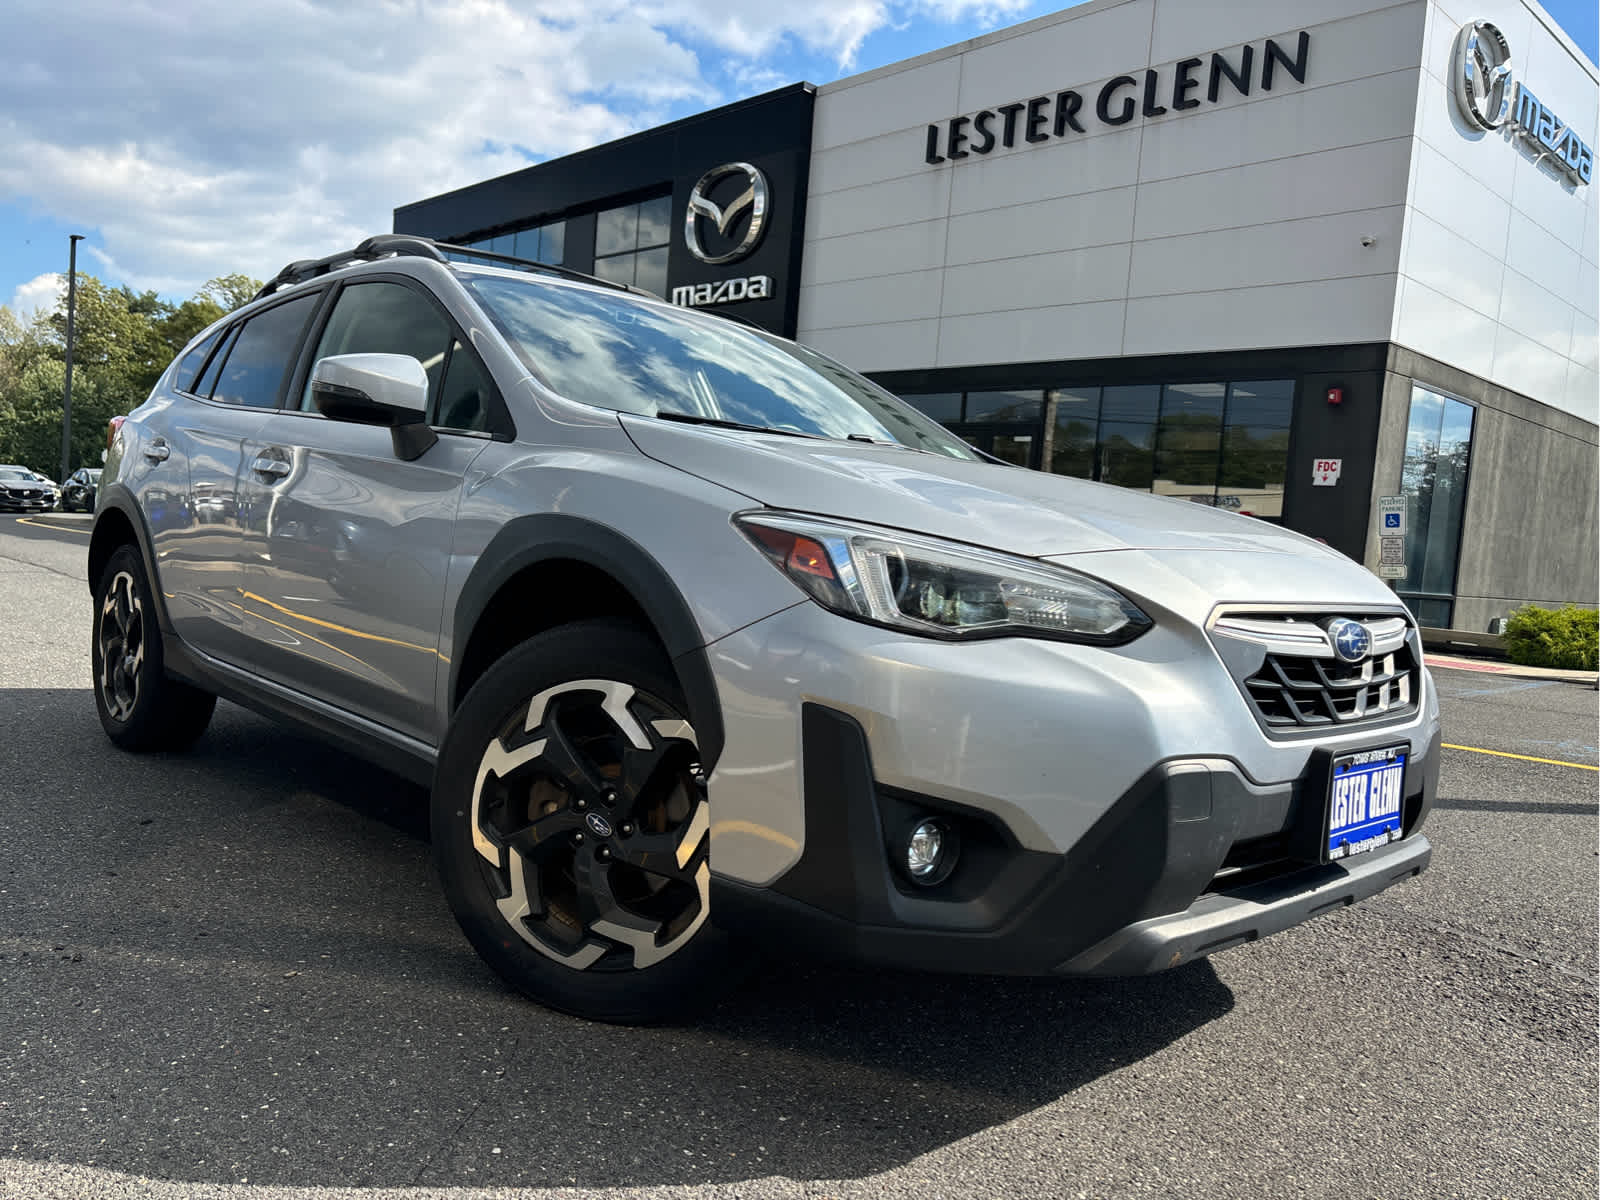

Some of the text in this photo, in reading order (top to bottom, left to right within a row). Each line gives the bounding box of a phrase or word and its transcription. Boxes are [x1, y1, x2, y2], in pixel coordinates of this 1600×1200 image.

[926, 31, 1310, 164] LESTER GLENN
[1317, 461, 1337, 472] FDC
[1329, 767, 1402, 830] LESTER GLENN
